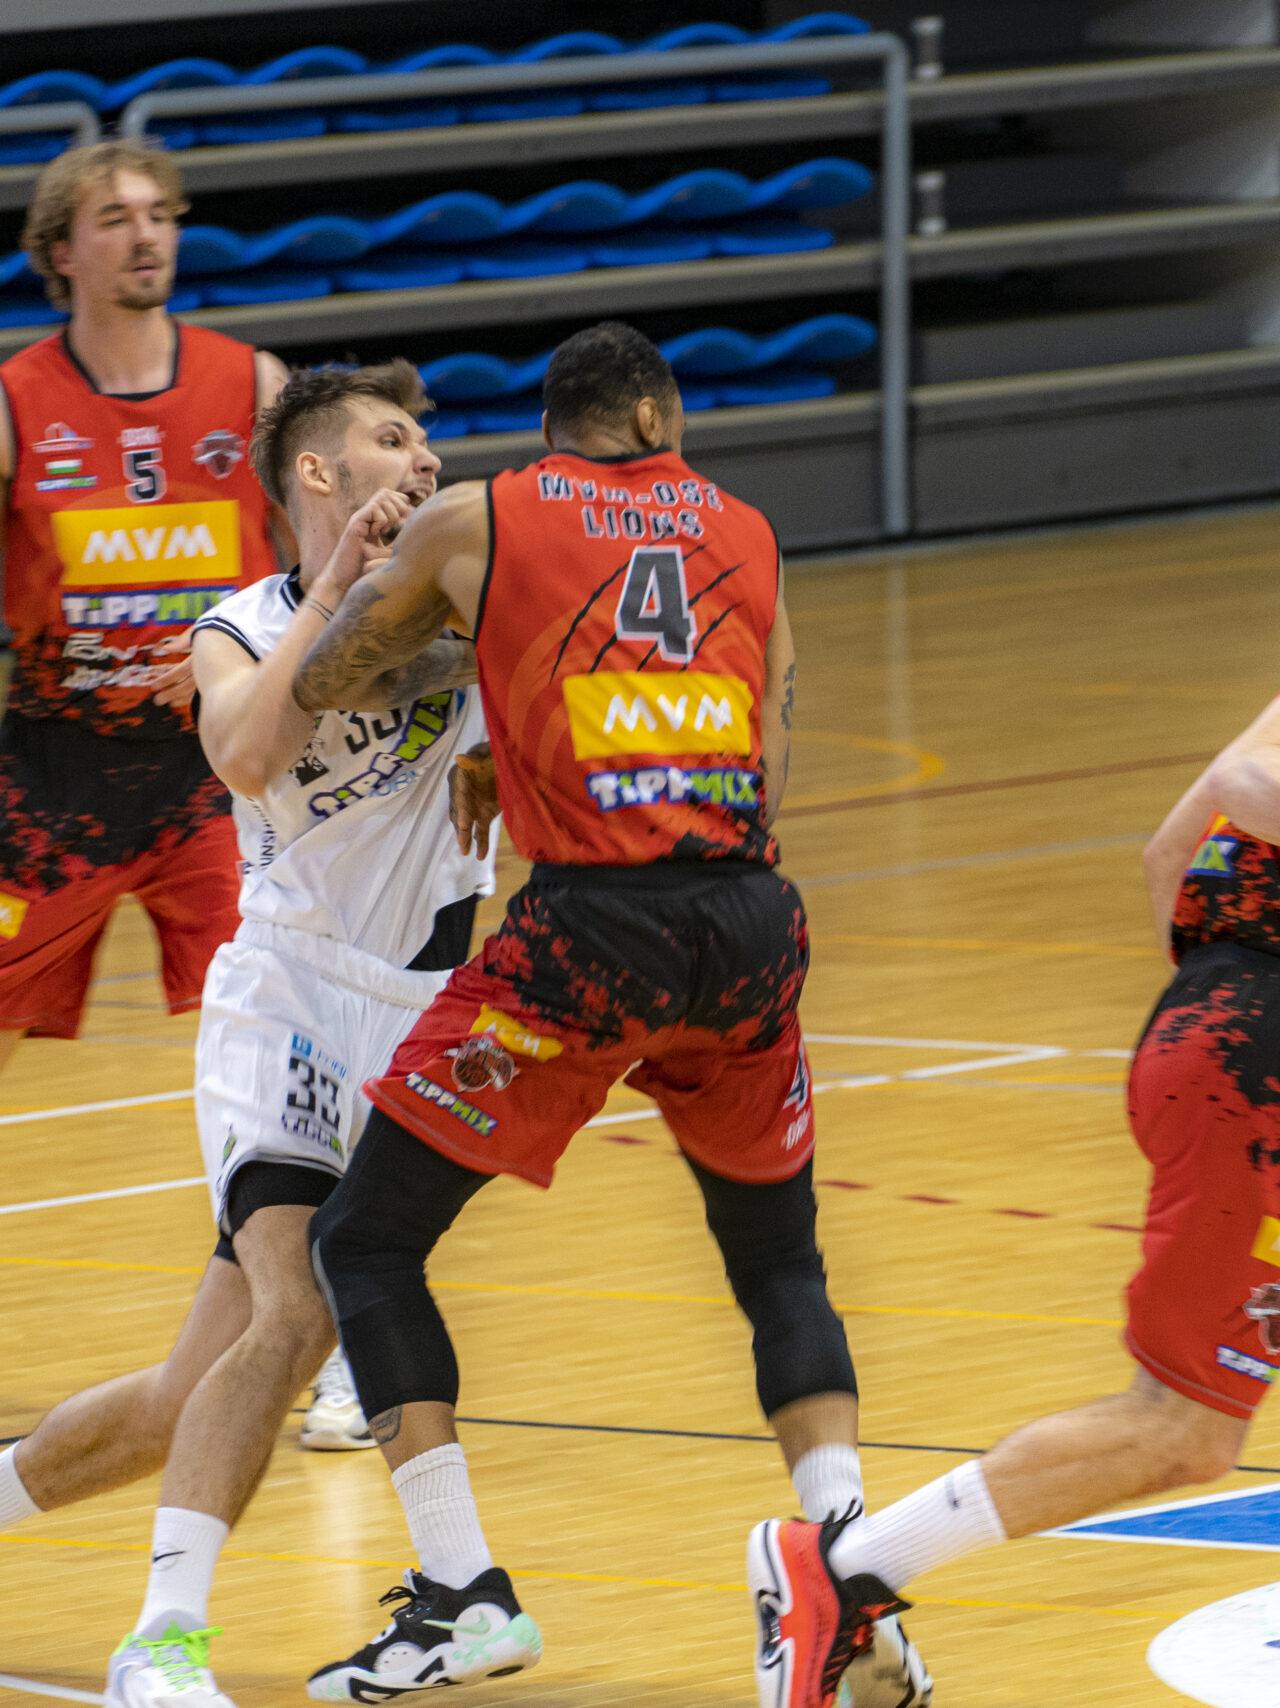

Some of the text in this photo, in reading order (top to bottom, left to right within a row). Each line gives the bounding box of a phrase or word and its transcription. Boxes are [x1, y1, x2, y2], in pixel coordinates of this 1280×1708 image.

[122, 448, 168, 503] 5
[581, 504, 704, 539] LIONS
[82, 524, 217, 563] MVM
[615, 545, 698, 664] 4
[603, 693, 734, 735] MVM
